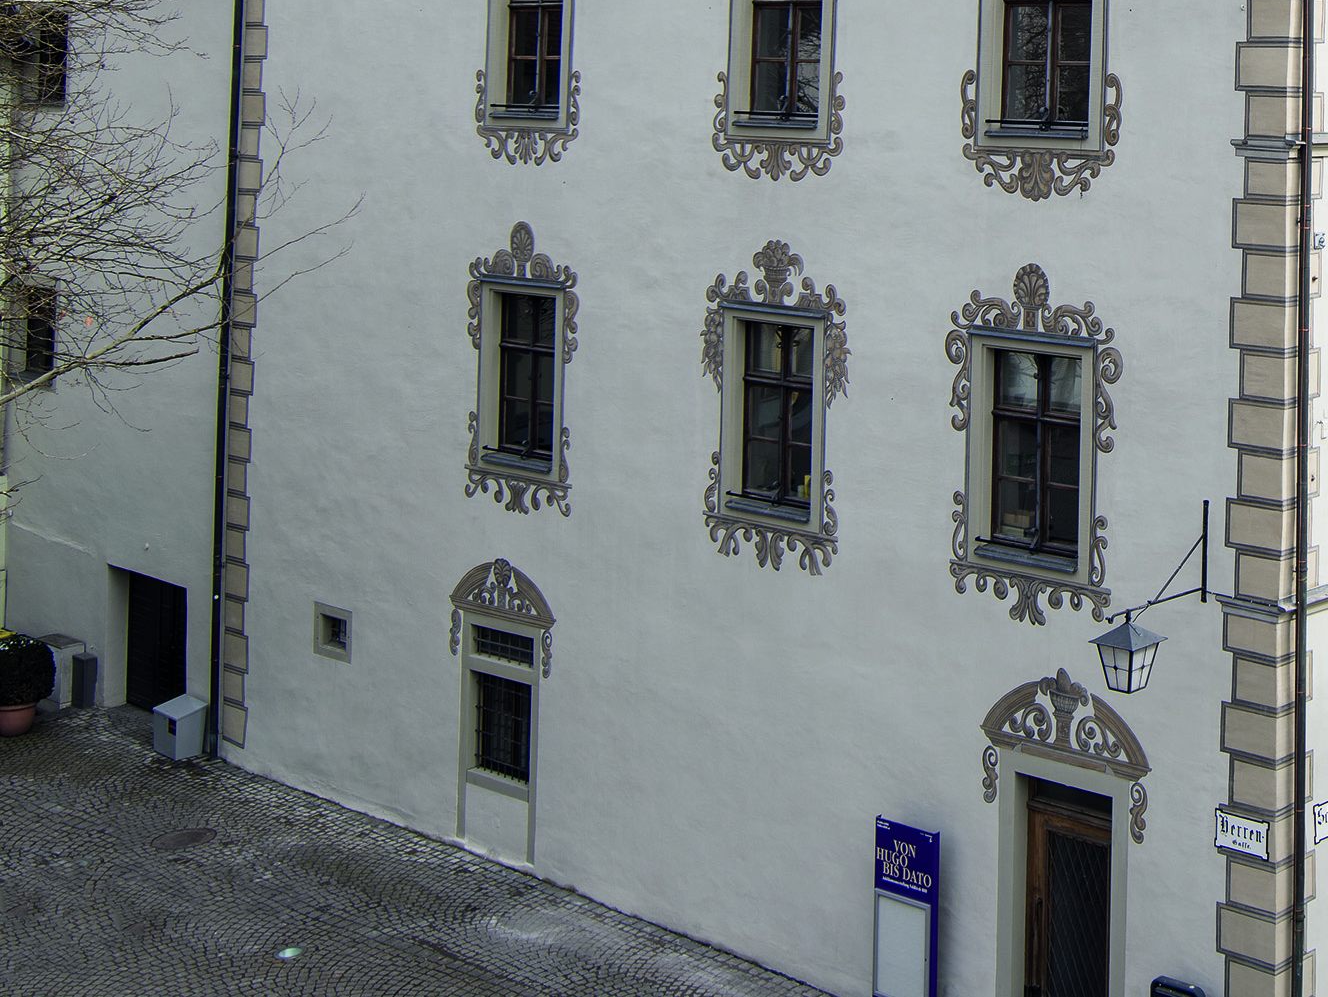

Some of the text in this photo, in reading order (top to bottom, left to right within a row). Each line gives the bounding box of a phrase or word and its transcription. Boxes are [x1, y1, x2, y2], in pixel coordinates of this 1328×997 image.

[876, 846, 908, 868] HUGO
[893, 839, 916, 858] VON
[882, 861, 900, 878] BIS
[902, 867, 932, 888] DATO
